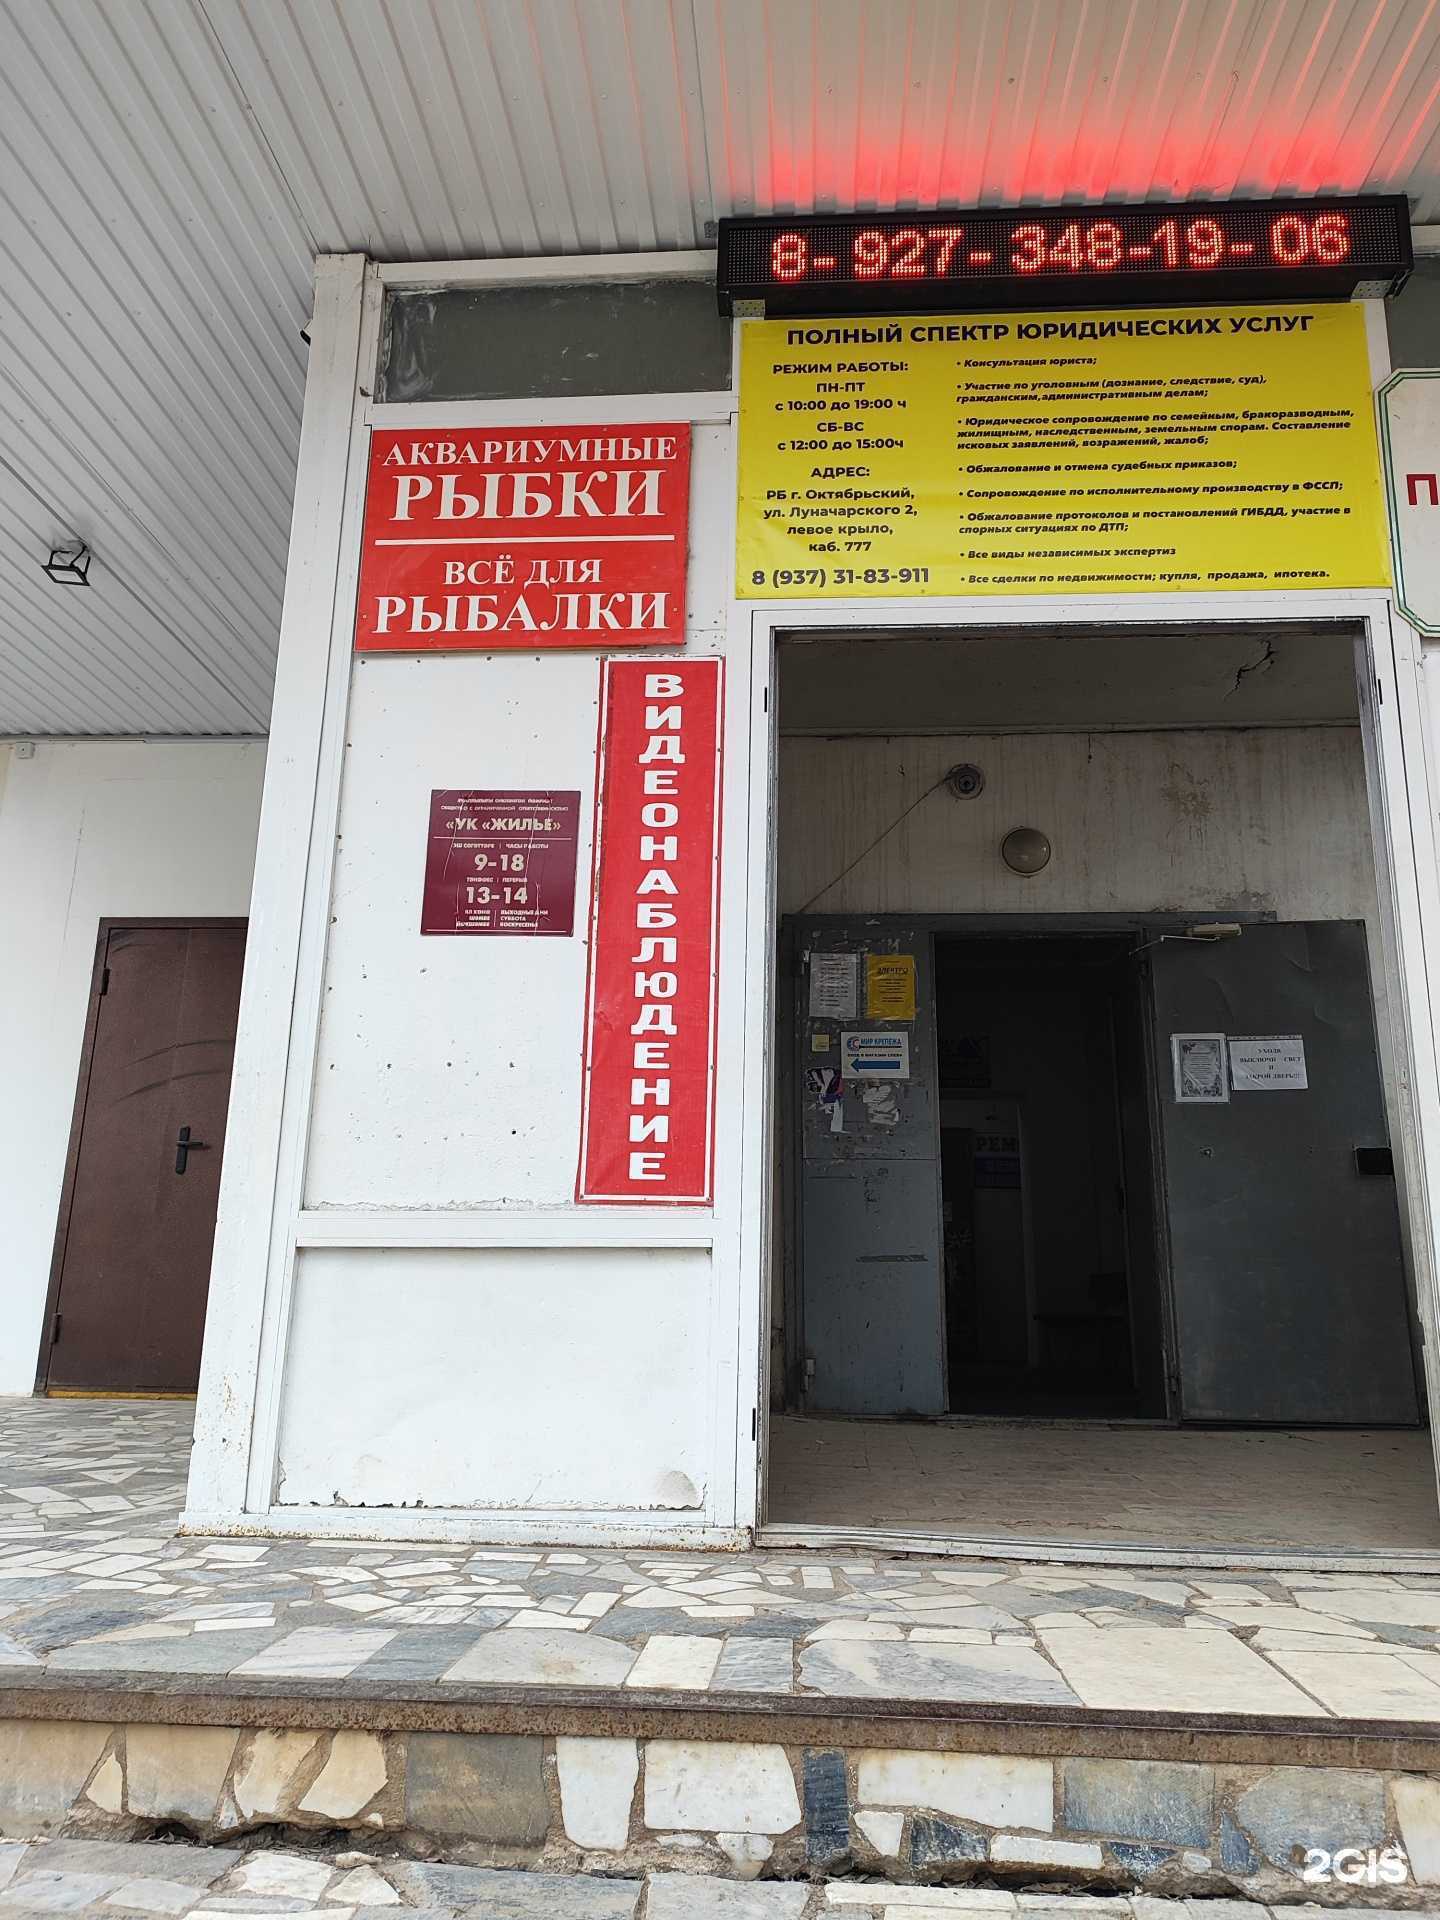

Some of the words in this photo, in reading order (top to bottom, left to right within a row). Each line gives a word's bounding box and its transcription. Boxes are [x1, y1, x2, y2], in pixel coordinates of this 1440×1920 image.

[1271, 214, 1348, 263] 06
[787, 323, 903, 345] ПОЛНЫЙ
[910, 324, 1009, 342] СПЕКТР
[1017, 318, 1223, 341] ЮРИДИЧЕСКИХ
[1228, 315, 1314, 333] УСЛУГ
[773, 364, 832, 374] РЕЖИМ
[837, 361, 908, 373] РАБОТЫ:
[964, 358, 1046, 368] Консультация
[1049, 357, 1096, 366] юриста;
[816, 382, 866, 393] ПН-ПТ
[965, 382, 1010, 391] Участие
[1031, 380, 1099, 391] уголовным
[1101, 378, 1167, 389] (дознание,
[1169, 376, 1235, 386] следствие,
[1238, 375, 1267, 385] суд),
[1164, 389, 1209, 399] делам;
[775, 402, 783, 411] с
[787, 400, 827, 410] 10:00
[830, 401, 850, 411] до
[854, 398, 893, 409] 19:00
[897, 400, 906, 408] ч
[965, 417, 1049, 427] Юридическое
[1052, 414, 1150, 425] сопровождение
[1152, 414, 1167, 422] по
[1170, 411, 1239, 421] семейным,
[1242, 409, 1354, 420] бракоразводным,
[816, 421, 865, 432] СБ-ВС
[957, 429, 1032, 439] жилищным,
[1035, 426, 1141, 437] наследственным,
[1144, 423, 1217, 433] земельным
[1220, 422, 1269, 433] спорам.
[1272, 421, 1351, 430] Составление
[777, 442, 786, 450] с
[790, 439, 828, 450] 12:00
[832, 441, 852, 451] до
[856, 438, 904, 449] 15:00ч
[957, 441, 1009, 450] исковых
[1011, 438, 1079, 449] заявлений,
[1082, 437, 1161, 447] возражений,
[1163, 435, 1209, 445] жалоб;
[382, 436, 678, 466] АКВАРИУМНЫЕ
[811, 466, 870, 479] АДРЕС:
[966, 464, 1050, 473] Обжалование
[1064, 463, 1108, 471] отмена
[1111, 460, 1172, 471] судебных
[1174, 460, 1237, 471] приказов;
[389, 469, 667, 521] РЫБКИ
[767, 489, 787, 500] РБ
[791, 491, 801, 500] г.
[805, 487, 915, 501] Октябрьский,
[966, 488, 1066, 499] Сопровождение
[1069, 488, 1084, 496] по
[1087, 485, 1199, 496] исполнительному
[1202, 483, 1289, 494] производству
[1302, 481, 1344, 491] ФССП;
[763, 509, 785, 519] ул.
[789, 506, 900, 519] Луначарского
[904, 504, 918, 516] 2,
[967, 512, 1053, 521] Обжалование
[1055, 511, 1129, 521] протоколов
[1143, 508, 1238, 518] постановлений
[1241, 507, 1288, 517] ГИБДД,
[1291, 506, 1340, 517] участие
[787, 526, 834, 535] левое
[838, 524, 893, 536] крыло,
[959, 525, 1012, 535] спорных
[1015, 524, 1078, 534] ситуациях
[1098, 522, 1129, 532] ДТП;
[809, 541, 840, 552] каб.
[844, 541, 872, 551] 777
[967, 551, 988, 559] Все
[991, 550, 1025, 559] виды
[1027, 549, 1111, 558] независимых
[1114, 547, 1176, 558] экспертиз
[443, 554, 515, 585] ВСЁ
[524, 559, 603, 591] ДЛЯ
[752, 570, 765, 585] 8
[772, 568, 826, 589] (937)
[833, 567, 929, 584] 31-83-911
[968, 575, 989, 583] Все
[991, 574, 1036, 584] сделки
[1039, 574, 1054, 582] по
[1057, 572, 1156, 582] недвижимости;
[1159, 571, 1201, 582] купля,
[1207, 571, 1268, 581] продажа,
[1274, 569, 1330, 580] ипотека.
[372, 592, 671, 633] РЫБАЛКИ
[474, 853, 524, 872] 9-18
[466, 886, 528, 904] 13-14
[629, 674, 685, 1180] ВИДЕОНАБЛЮДЕНИЕ
